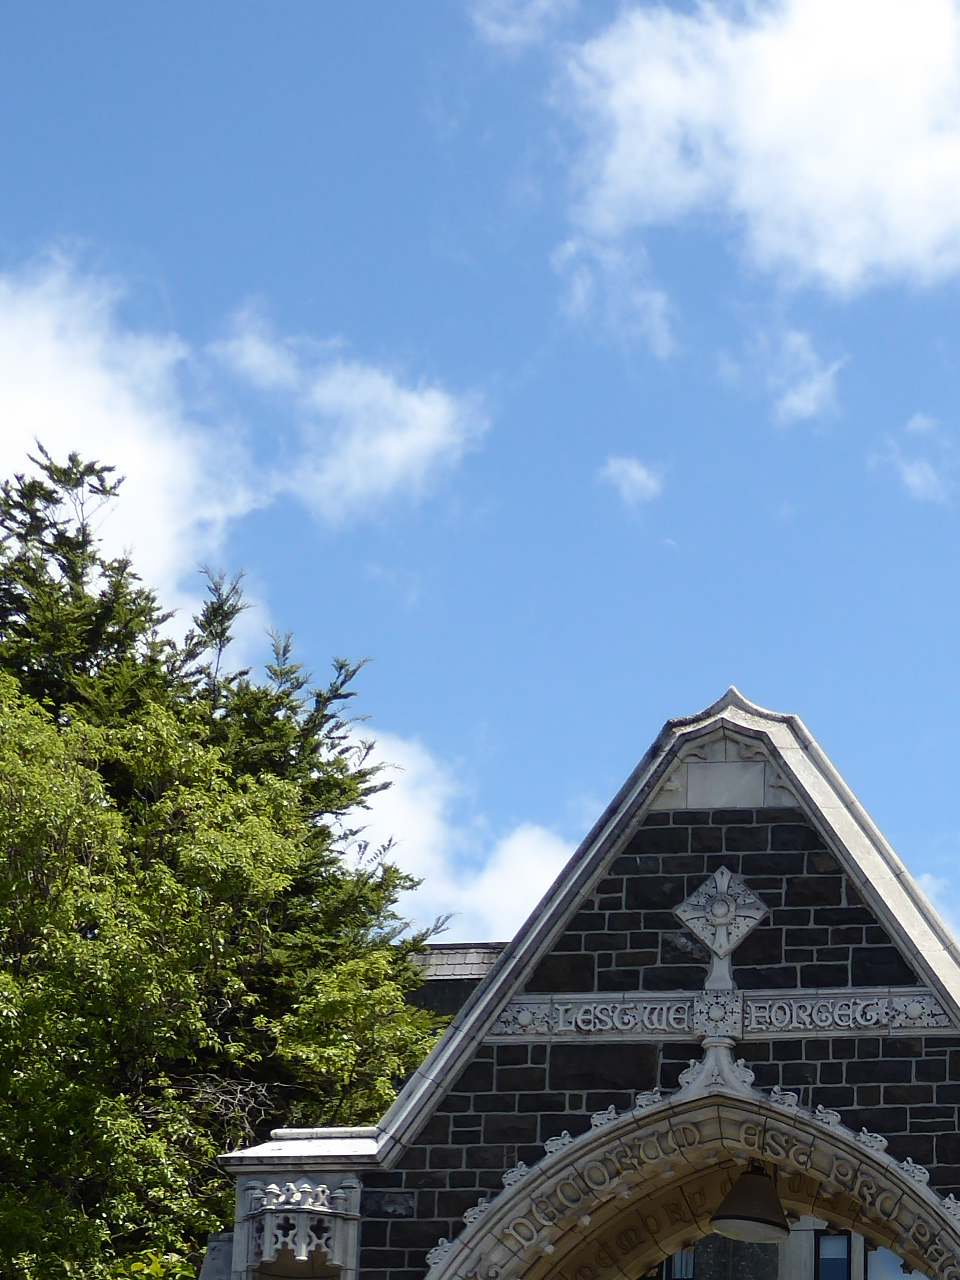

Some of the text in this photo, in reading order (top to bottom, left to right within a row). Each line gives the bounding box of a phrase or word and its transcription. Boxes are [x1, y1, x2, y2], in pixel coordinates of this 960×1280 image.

[553, 997, 886, 1033] LEST WE FORGET
[738, 1122, 814, 1172] EST
[829, 1155, 899, 1222] PRO
